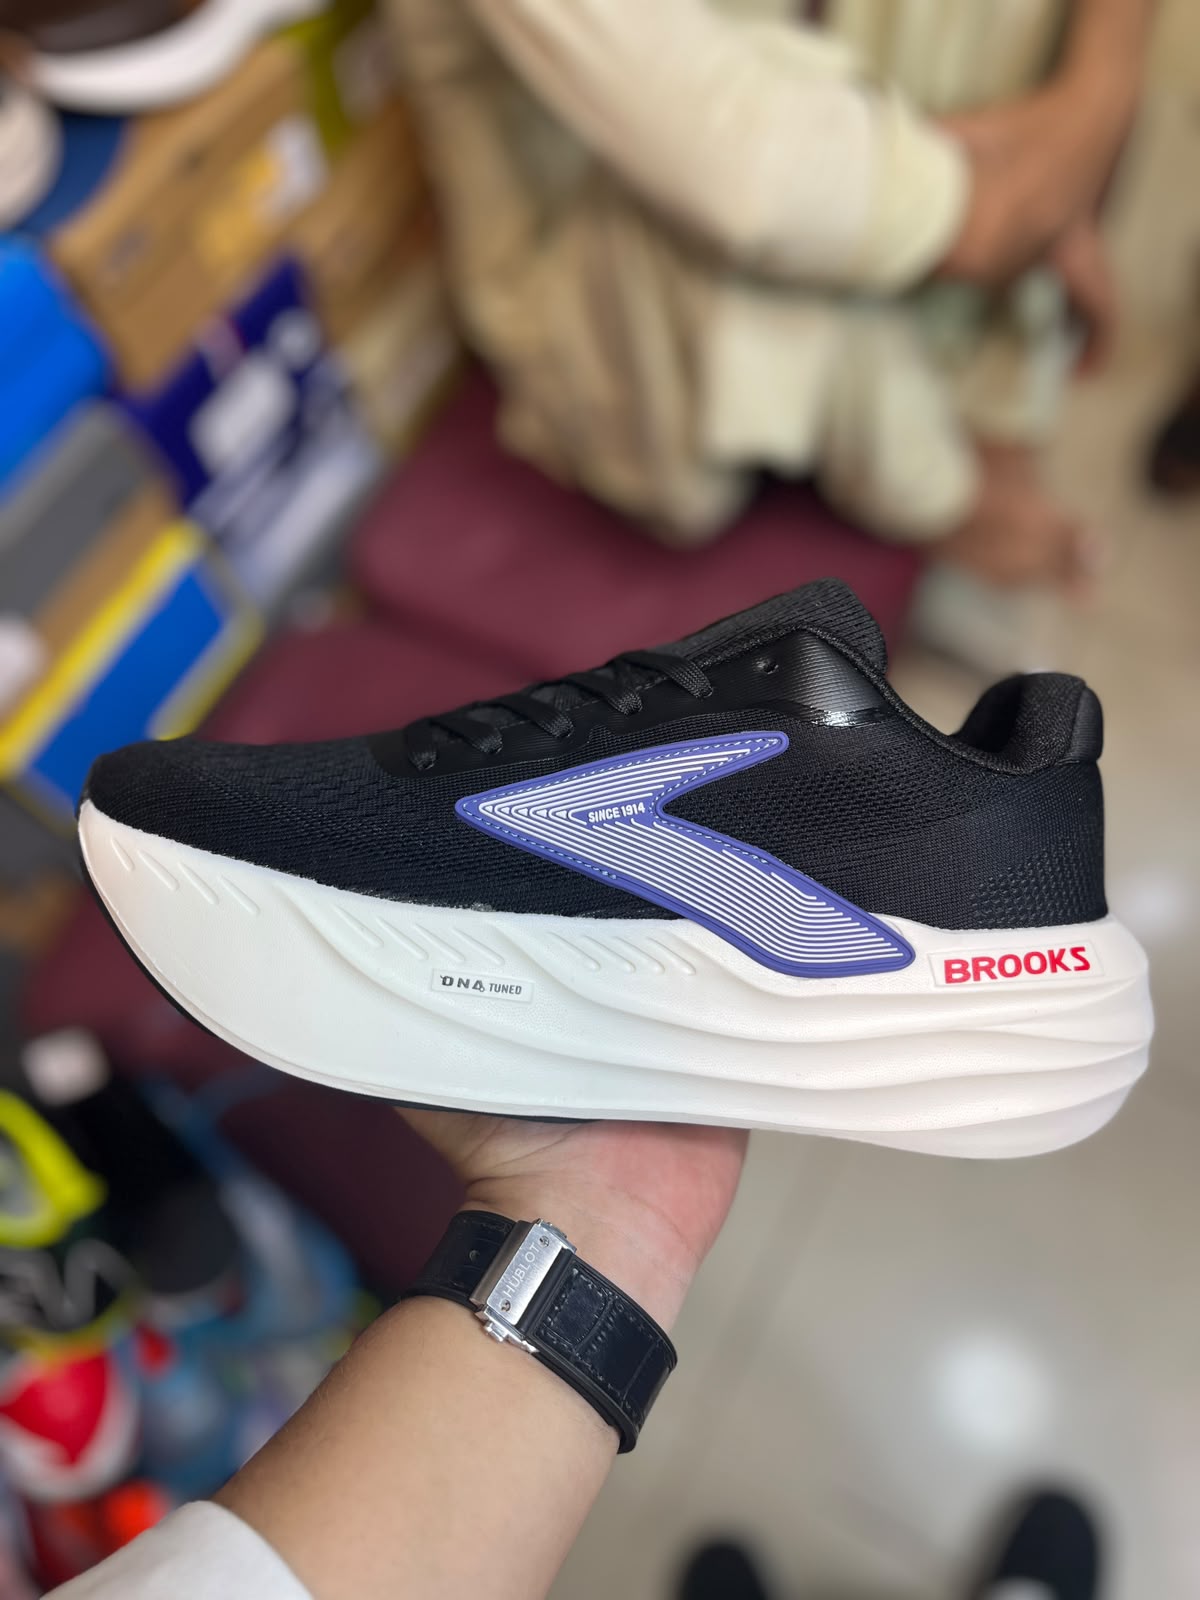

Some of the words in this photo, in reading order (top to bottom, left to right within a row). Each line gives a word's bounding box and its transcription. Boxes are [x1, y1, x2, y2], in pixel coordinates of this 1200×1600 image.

[588, 806, 620, 823] SINCE
[621, 802, 646, 817] 1914
[944, 946, 1091, 984] BROOKS
[489, 982, 522, 995] TUNED
[503, 1242, 540, 1298] HUBLOT
